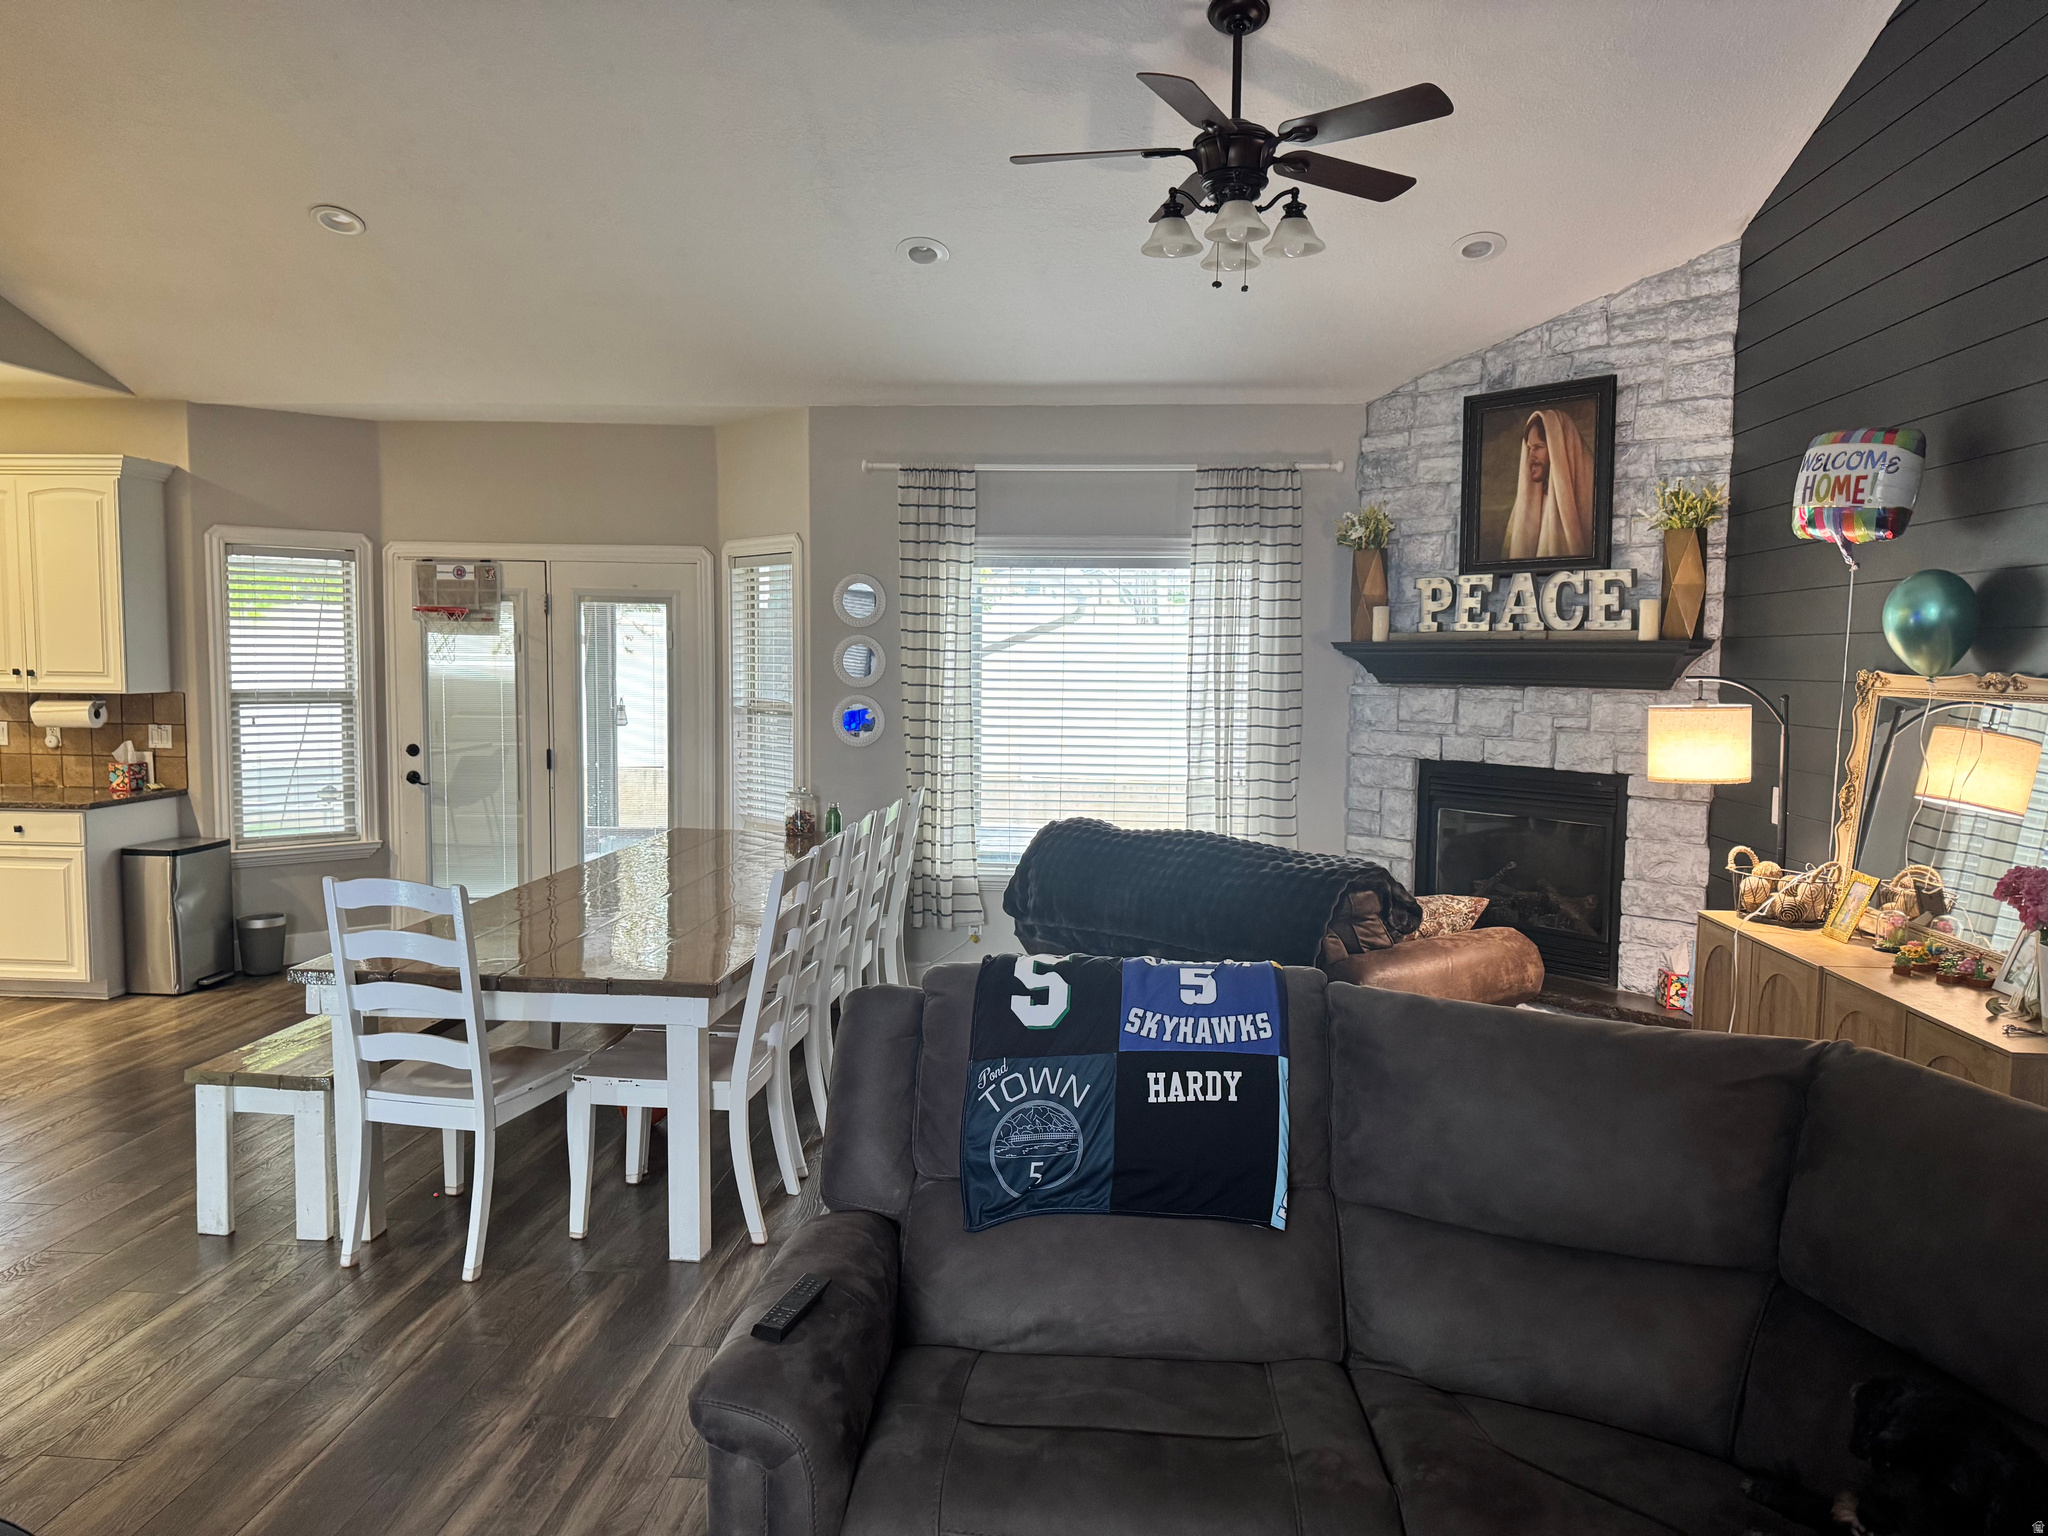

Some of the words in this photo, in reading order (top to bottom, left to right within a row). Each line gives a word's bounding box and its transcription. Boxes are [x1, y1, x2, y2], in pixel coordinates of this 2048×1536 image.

[1800, 450, 1901, 474] WELCOME
[1801, 471, 1879, 504] HOME!
[1414, 569, 1637, 632] PEACE
[1179, 967, 1217, 1005] 5
[1123, 1006, 1273, 1045] SKYHAWKS
[977, 1057, 1008, 1089] Pond
[1146, 1070, 1243, 1103] HARDY
[978, 1067, 1091, 1113] TOWN
[1029, 1161, 1044, 1190] 5
